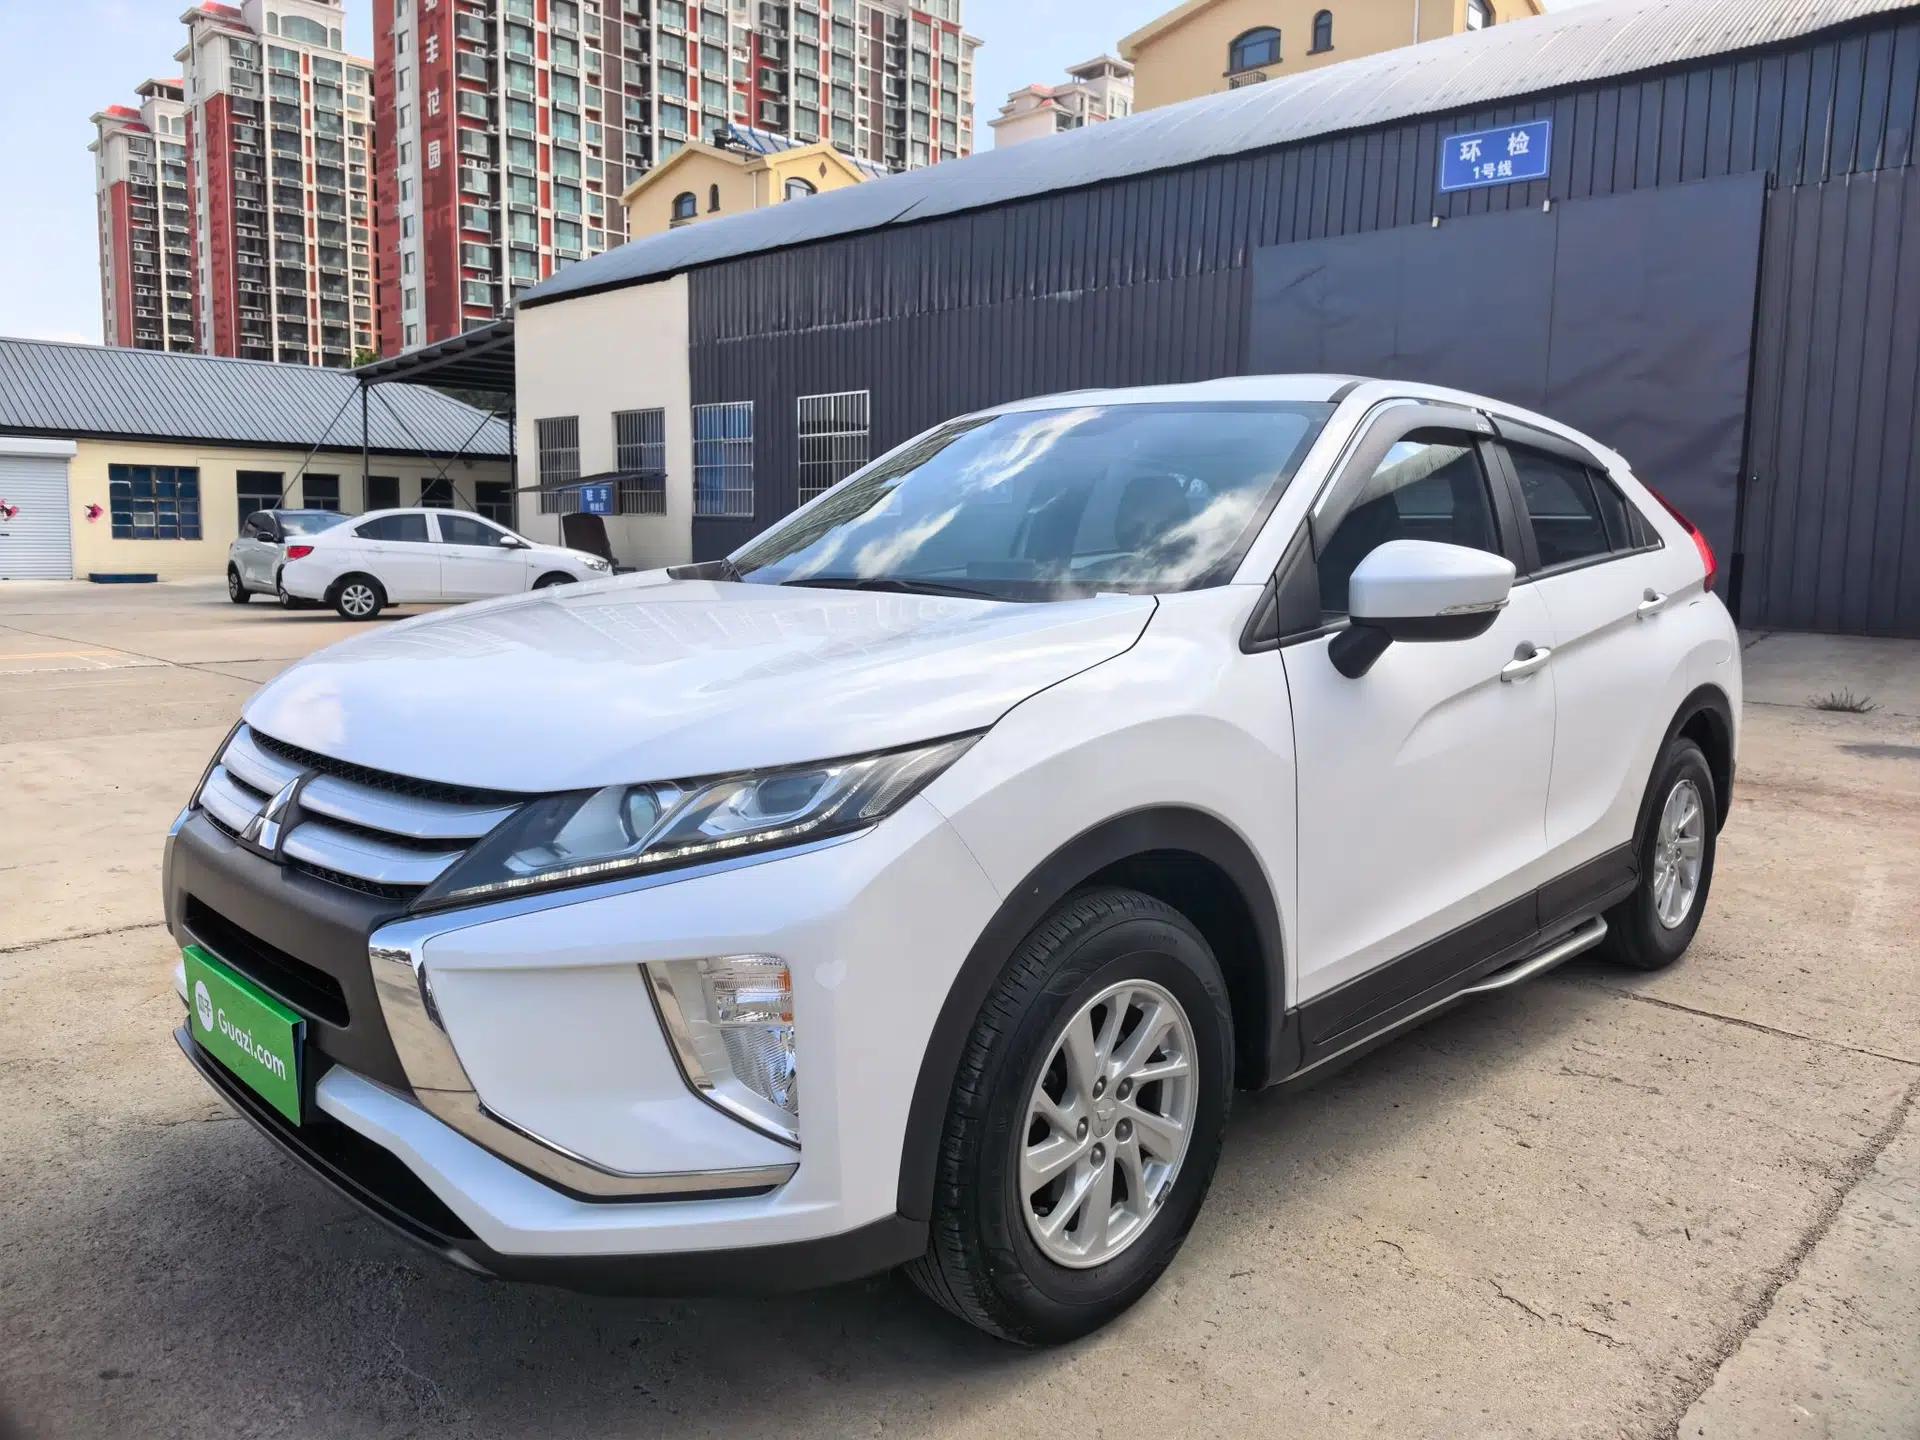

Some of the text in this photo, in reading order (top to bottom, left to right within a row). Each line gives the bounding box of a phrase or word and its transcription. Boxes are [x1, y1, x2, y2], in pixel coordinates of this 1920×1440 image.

[1460, 131, 1530, 163] 环检
[1473, 160, 1513, 179] 1号线
[217, 1007, 287, 1081] Guazi.com
